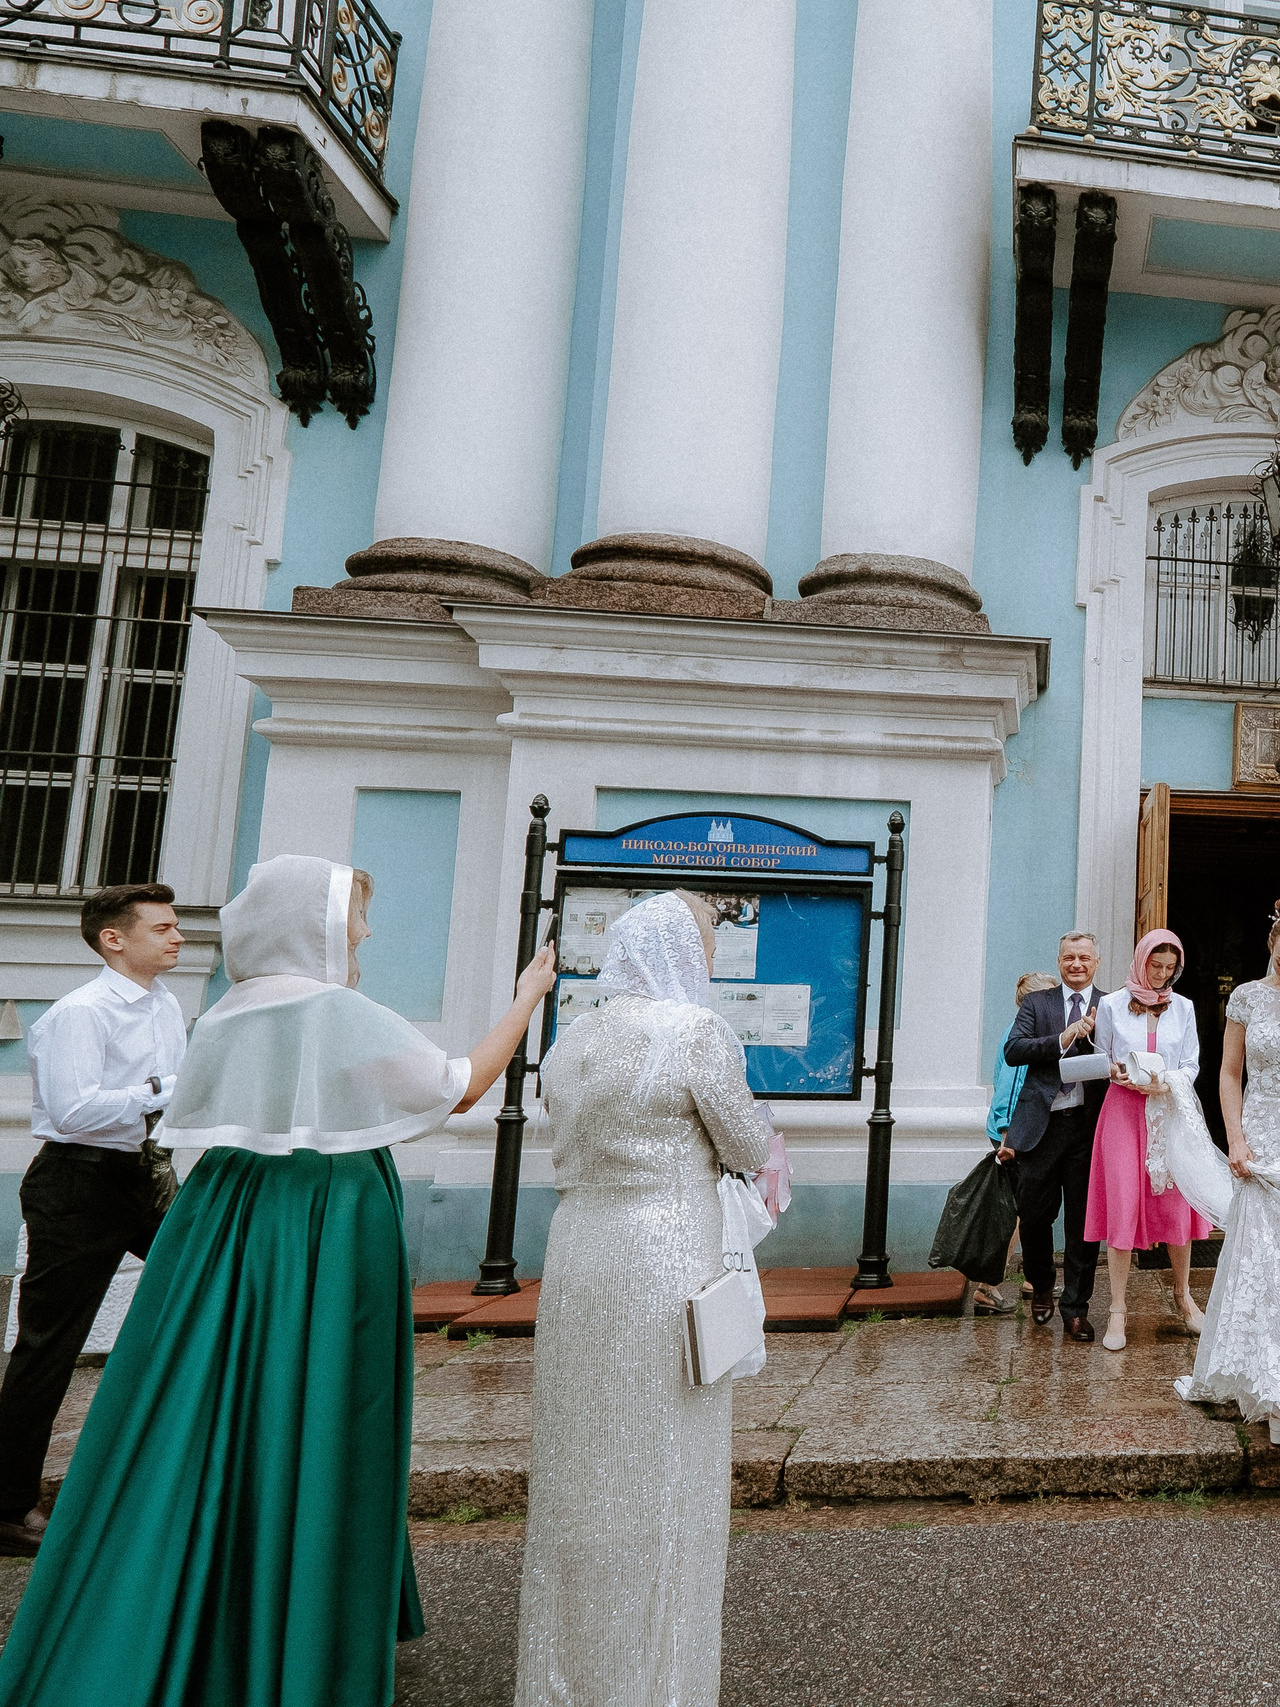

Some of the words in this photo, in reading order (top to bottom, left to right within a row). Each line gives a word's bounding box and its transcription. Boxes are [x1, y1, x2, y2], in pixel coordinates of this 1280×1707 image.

[621, 839, 818, 856] НИКОЛО-БОГОЯВЛЕНСКИЙ
[652, 853, 726, 867] МОРСКОЙ
[730, 856, 781, 868] СОБОР
